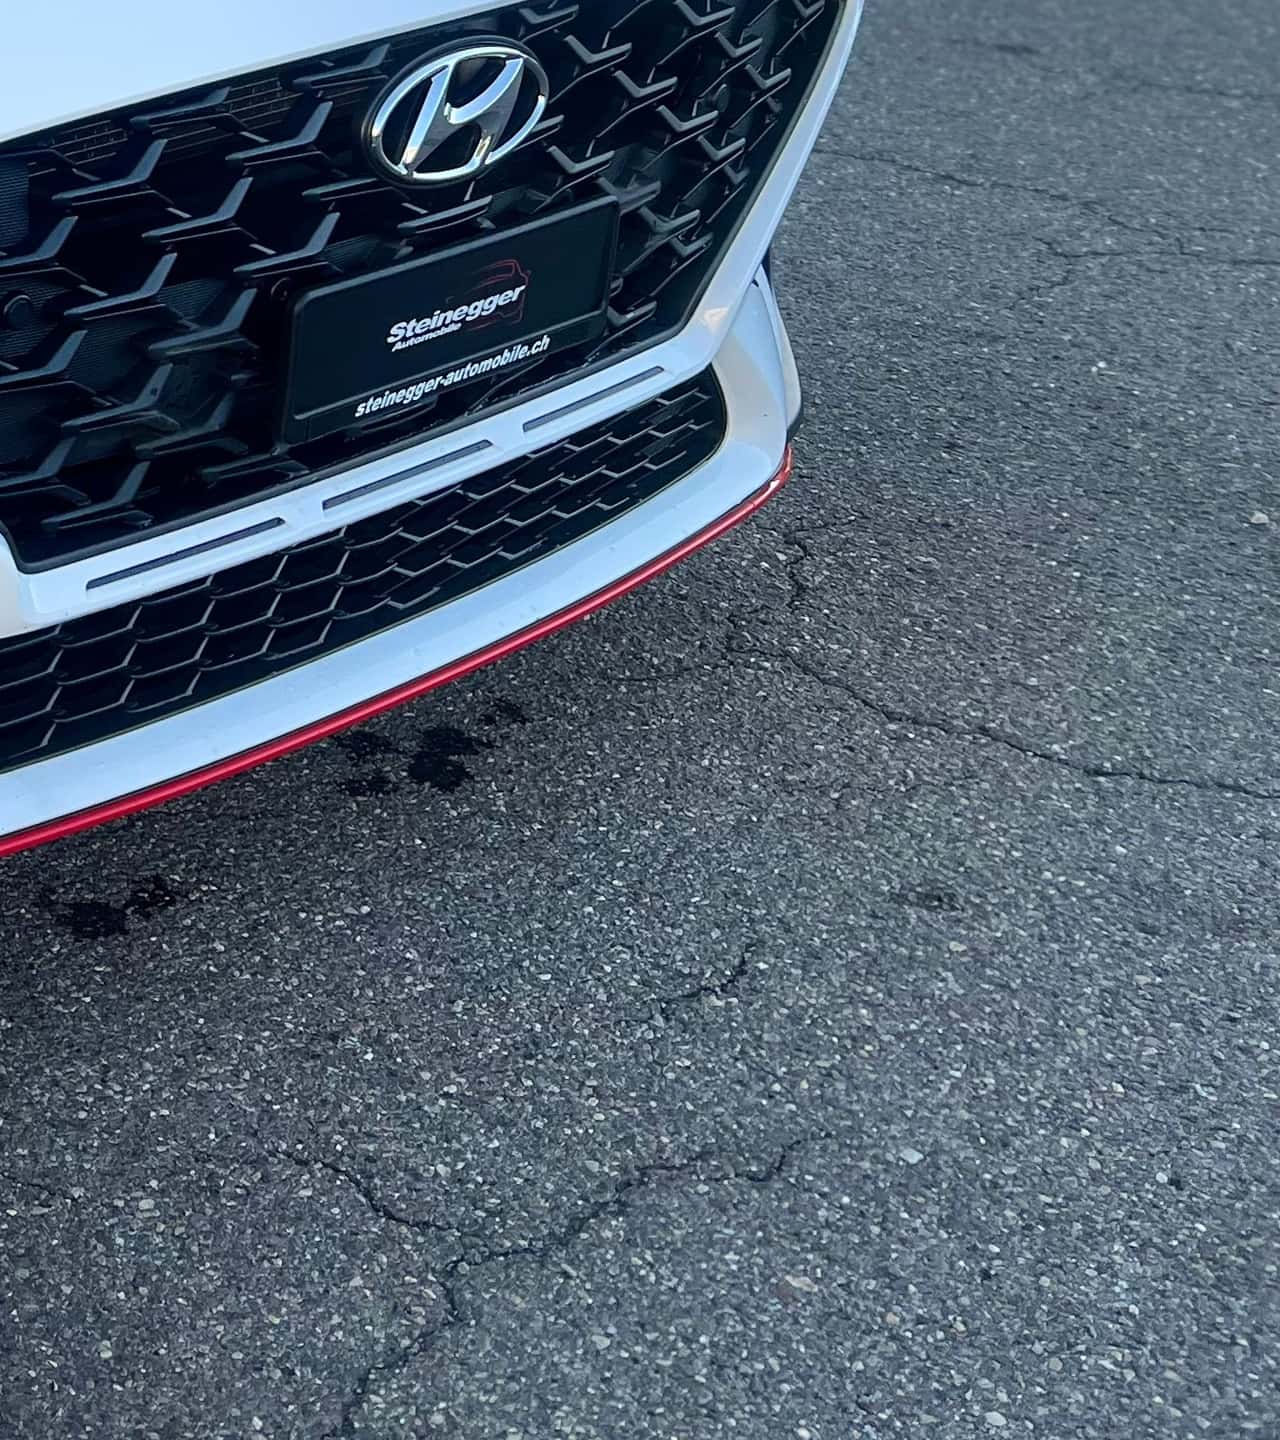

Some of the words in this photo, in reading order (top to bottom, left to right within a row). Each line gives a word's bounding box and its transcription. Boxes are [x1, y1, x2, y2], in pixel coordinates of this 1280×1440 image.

[387, 284, 526, 344] Steinegger
[391, 322, 462, 352] Automobile
[354, 334, 551, 418] steinegger-automobile.ch
